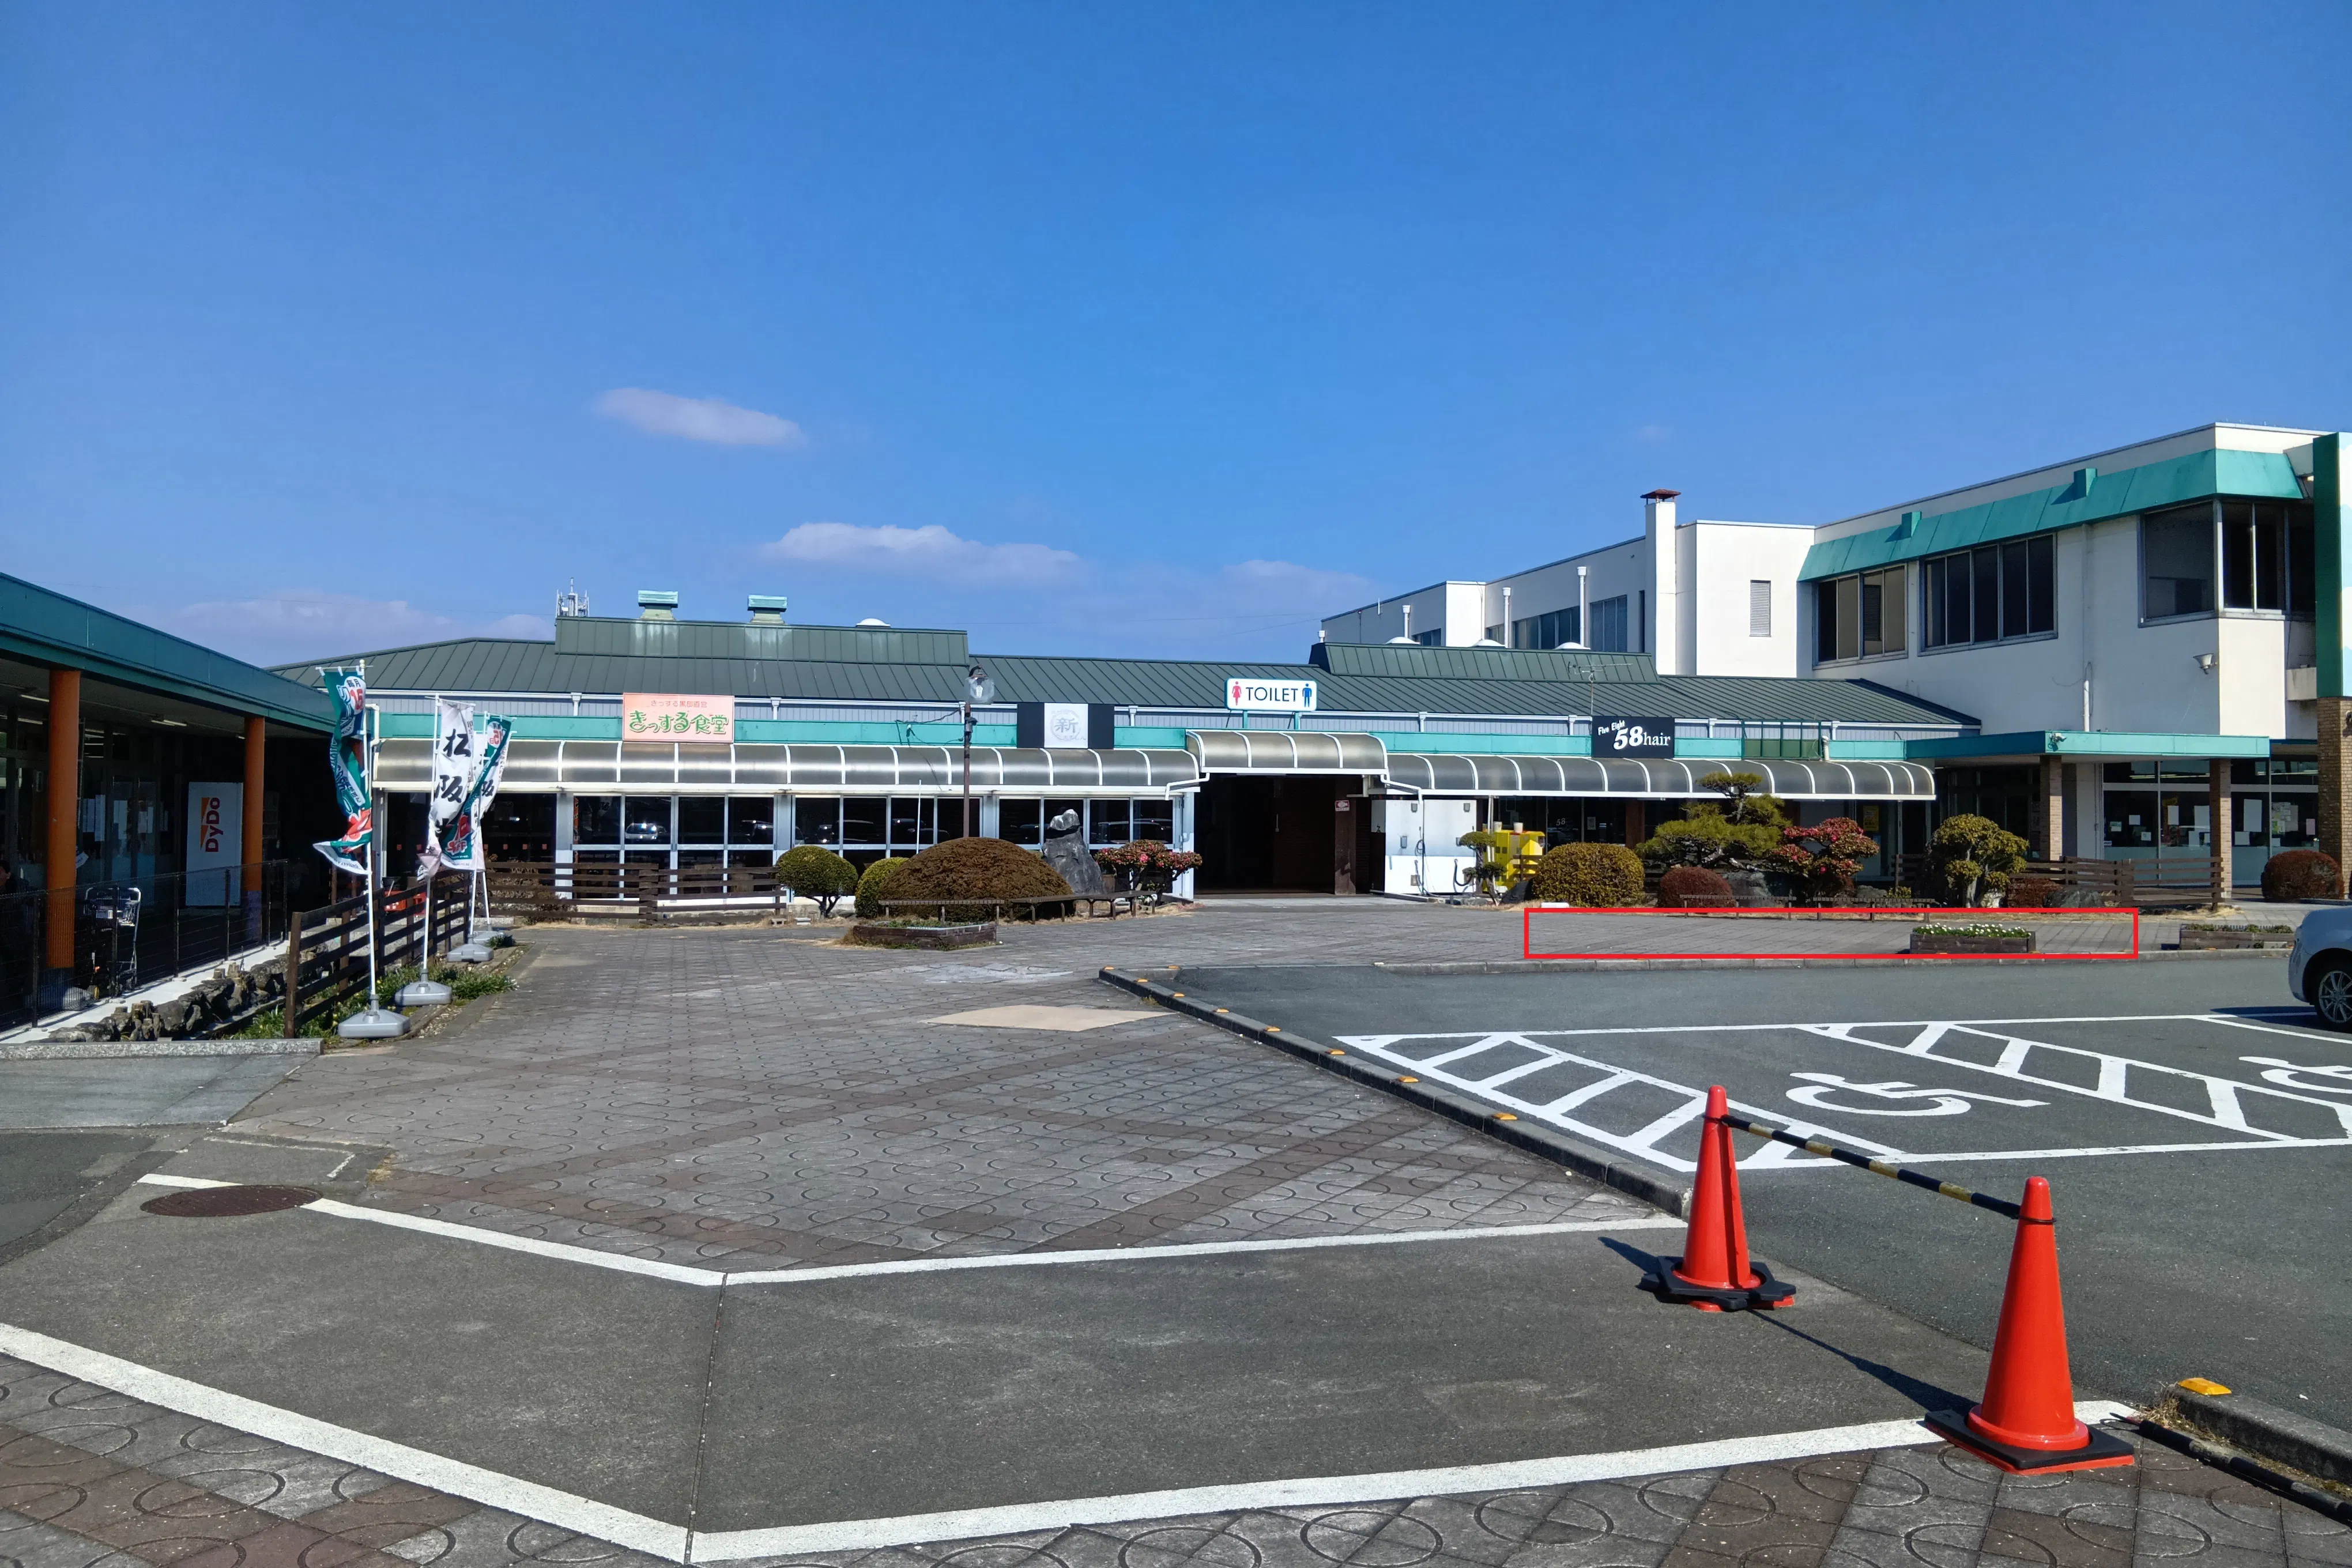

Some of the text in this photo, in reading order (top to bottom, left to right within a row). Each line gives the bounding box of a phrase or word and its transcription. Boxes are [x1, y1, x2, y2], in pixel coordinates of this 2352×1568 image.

[1245, 687, 1298, 702] TOILET
[629, 710, 729, 734] きっする食堂
[1054, 717, 1079, 733] 新
[1597, 719, 1625, 736] Five Eight
[205, 797, 223, 853] DyDo
[1556, 817, 1566, 826] 58
